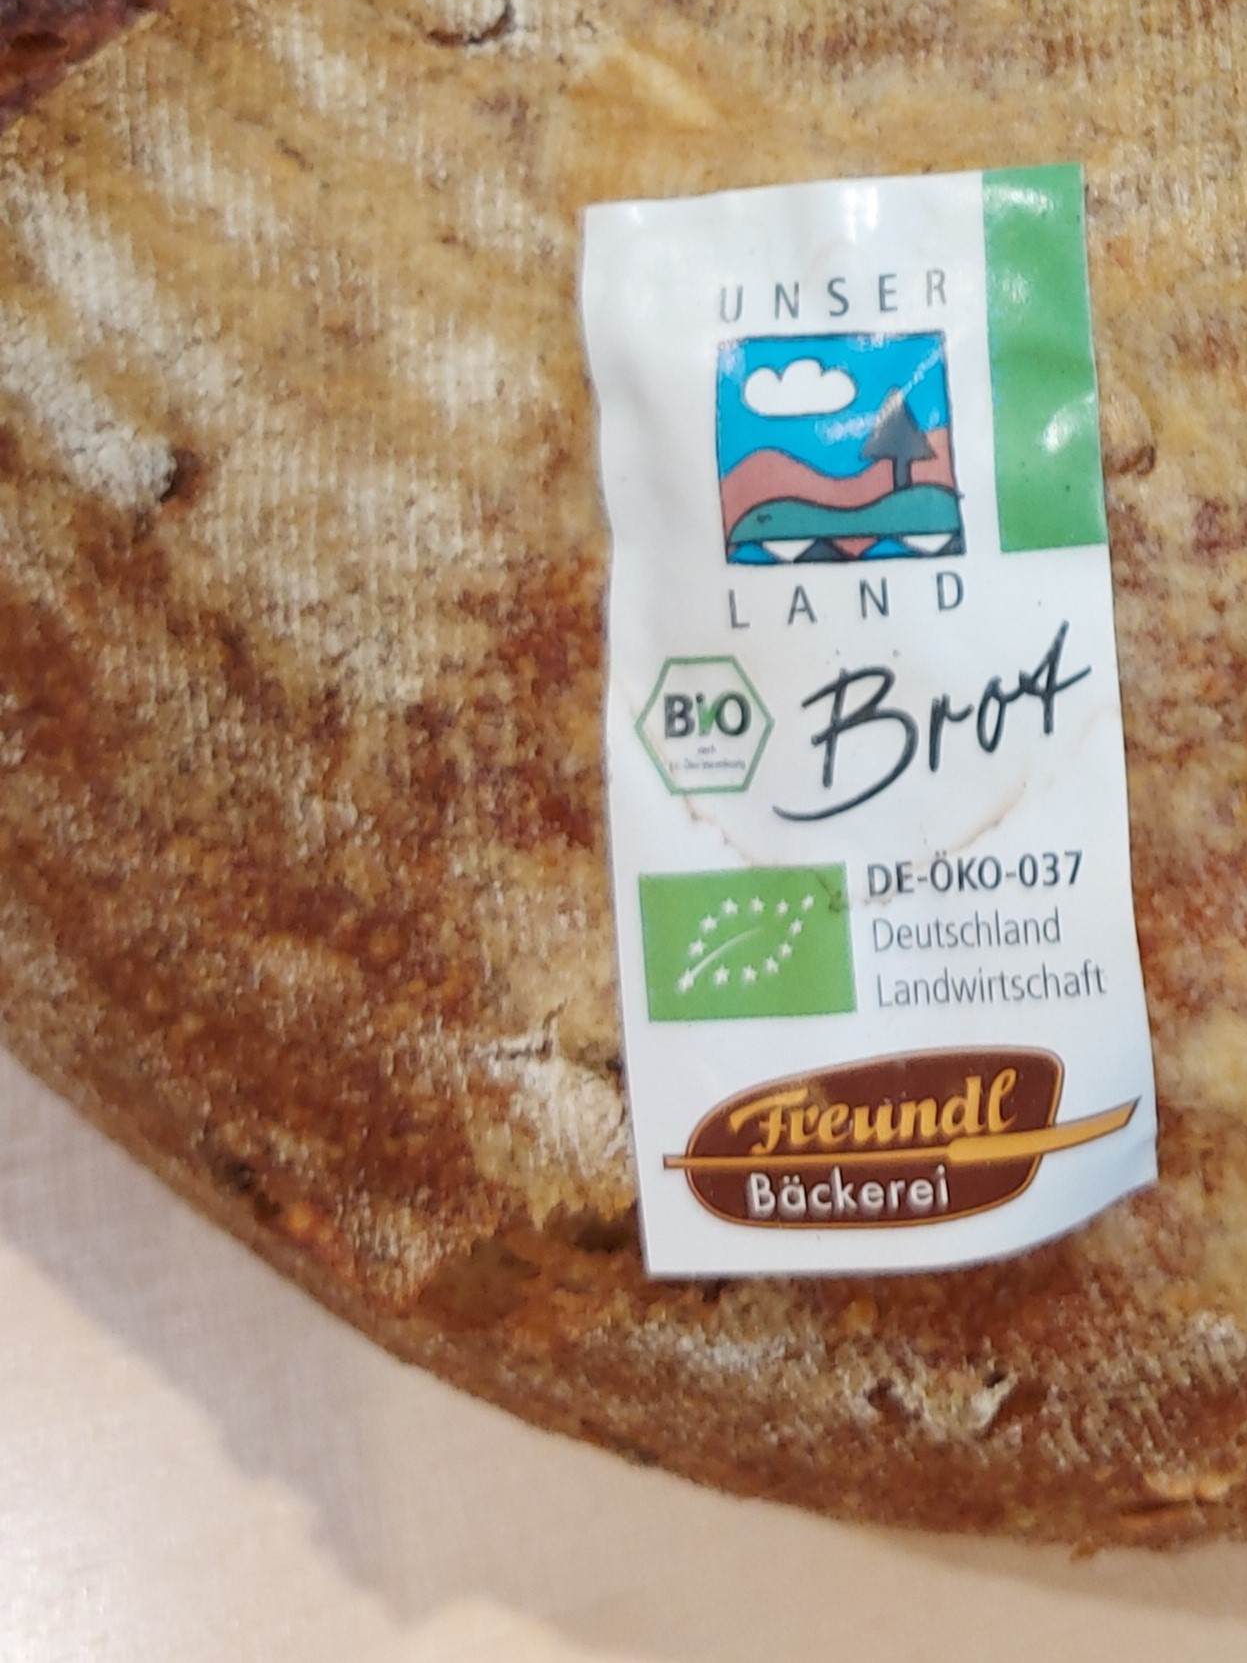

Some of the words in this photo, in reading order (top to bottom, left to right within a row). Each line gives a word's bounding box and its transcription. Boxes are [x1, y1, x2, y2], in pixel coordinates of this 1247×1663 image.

[719, 269, 948, 323] UNSER
[727, 570, 965, 629] LAND
[772, 620, 1092, 822] Brot
[867, 850, 1084, 896] DE-ÖKO-037
[872, 907, 1062, 953] Deutschland
[876, 962, 1107, 1008] Landwirtschaft
[729, 1068, 1019, 1156] Freundl
[747, 1164, 950, 1214] Bäckerei
